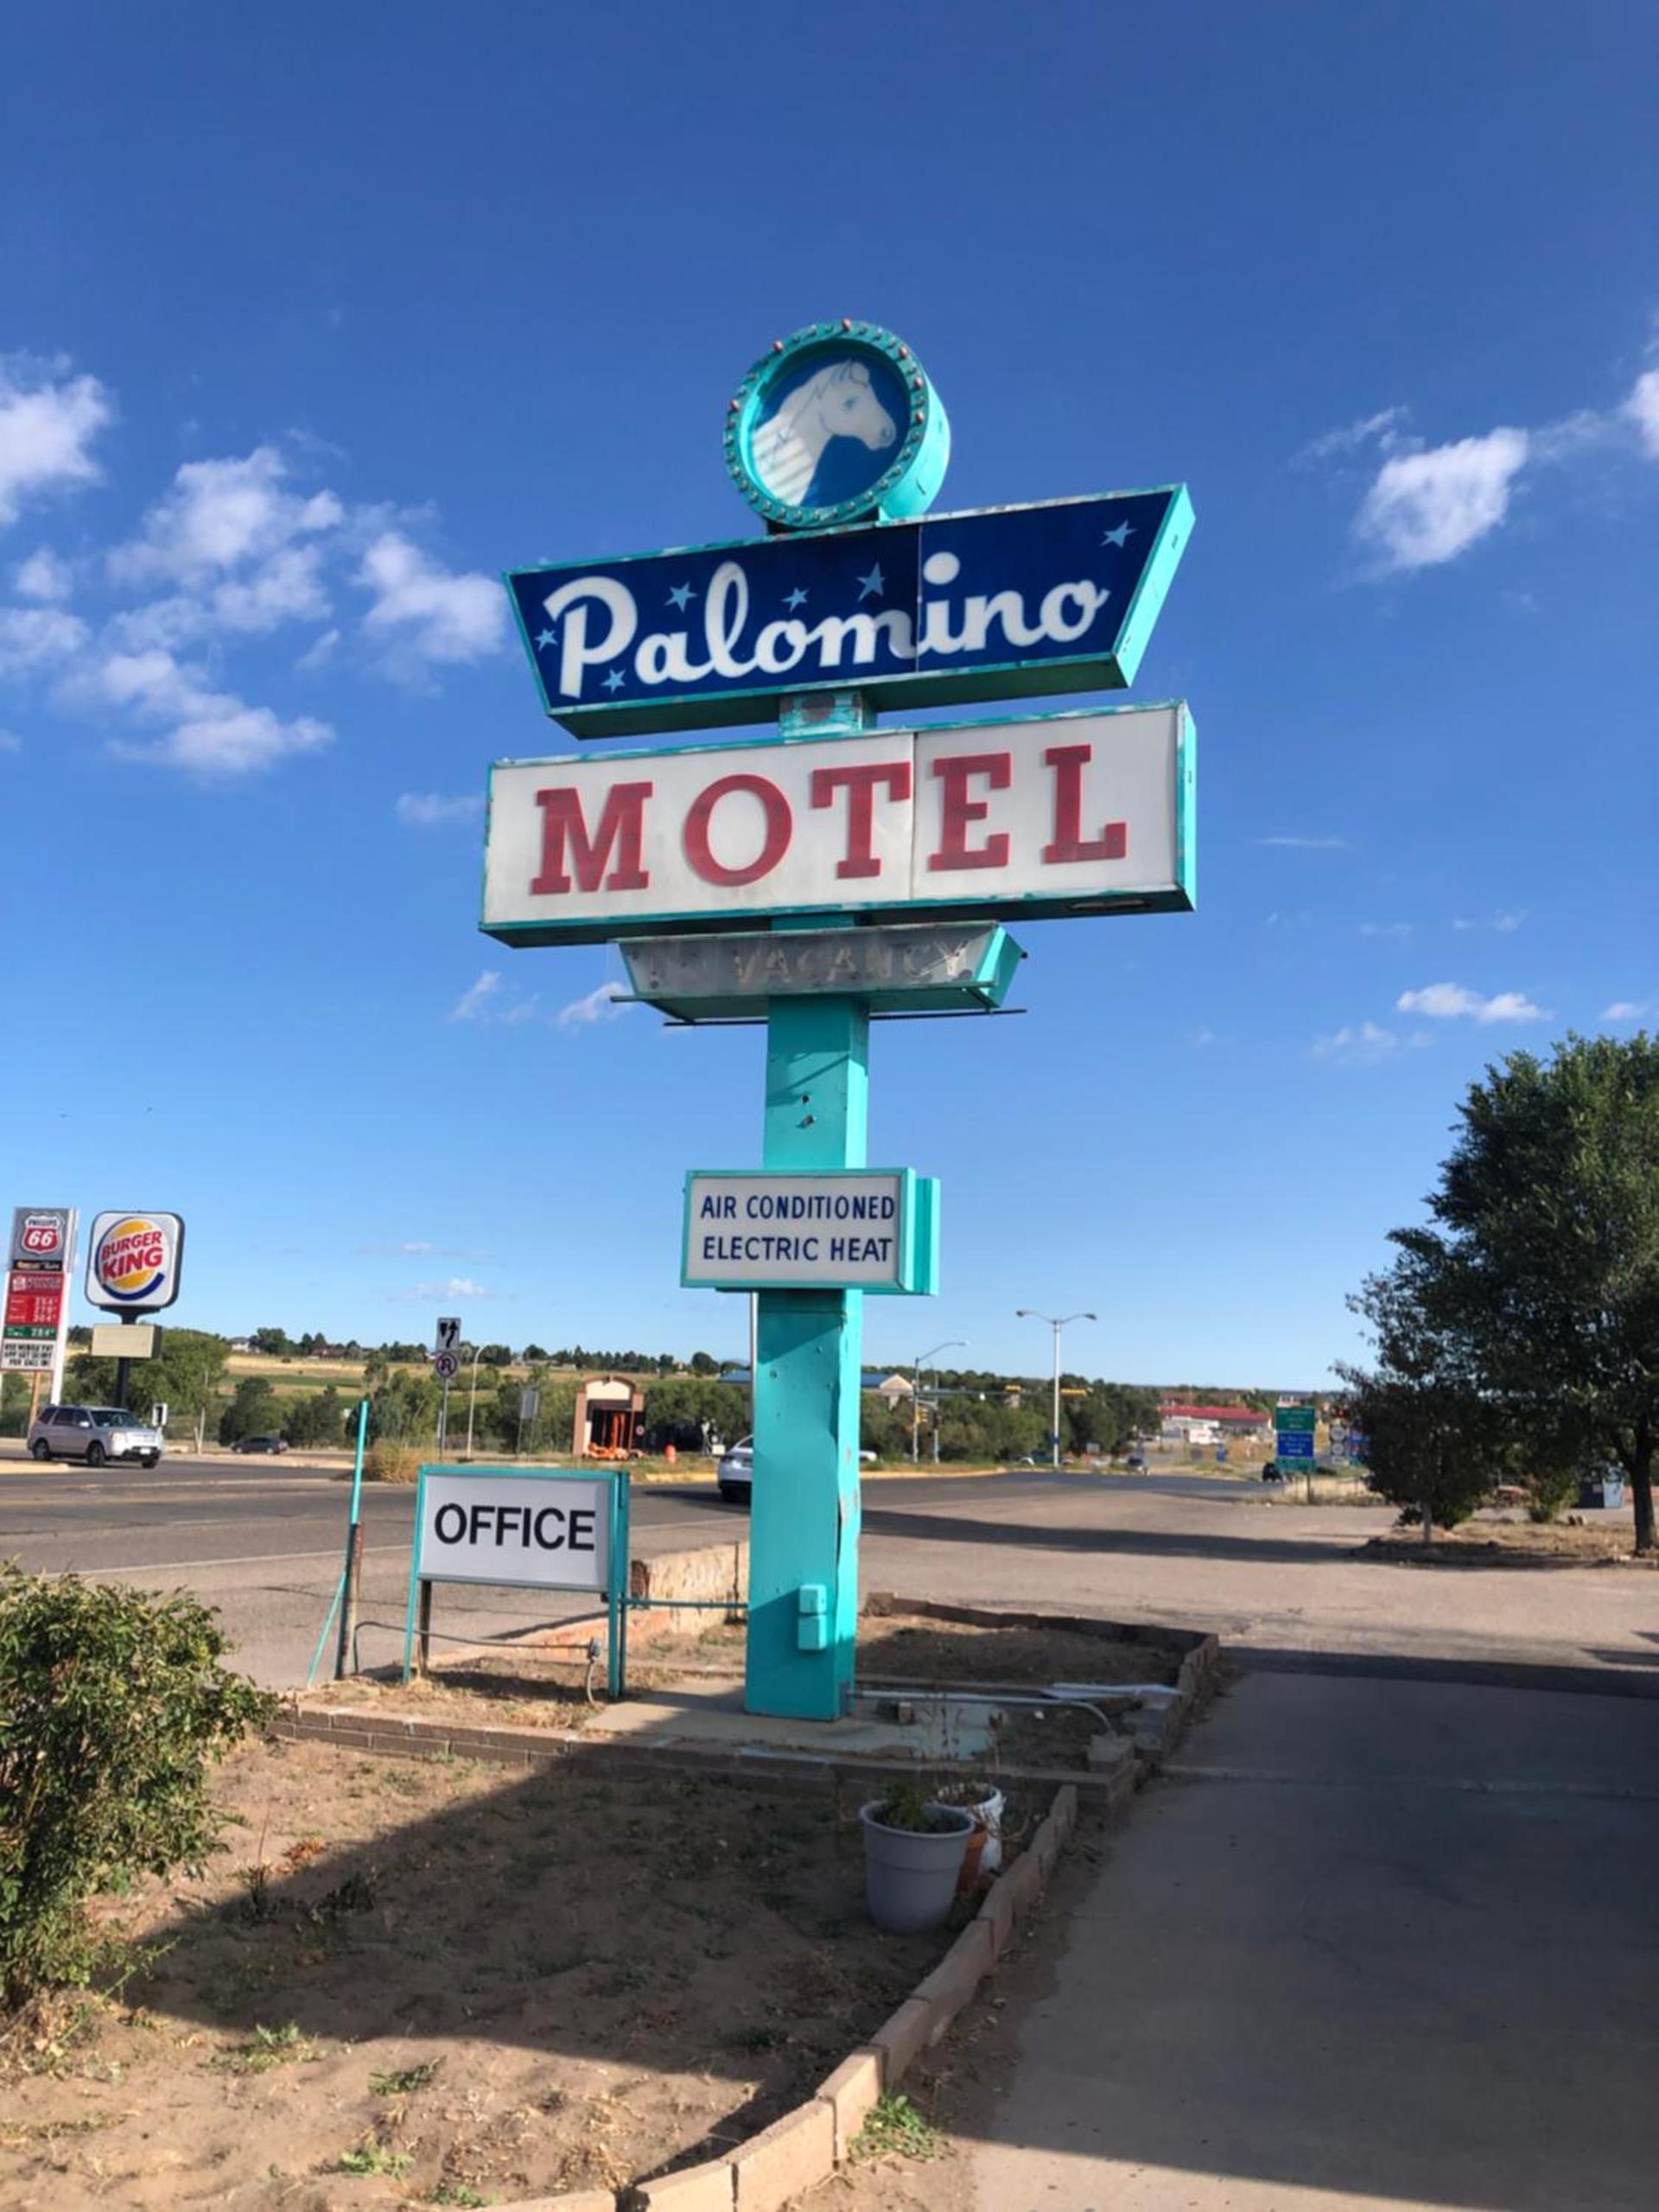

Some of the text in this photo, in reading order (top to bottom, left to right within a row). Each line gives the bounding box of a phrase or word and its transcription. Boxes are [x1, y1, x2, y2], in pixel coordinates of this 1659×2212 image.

[543, 550, 1110, 698] Palomino
[530, 743, 1128, 895] MOTEL
[700, 1195, 895, 1220] AIR CONDITIONED
[28, 1230, 54, 1247] 66
[102, 1230, 163, 1260] BURGER
[702, 1236, 893, 1262] ELECTRIC HEAT
[102, 1247, 164, 1279] KING
[435, 1503, 595, 1551] OFFICE
